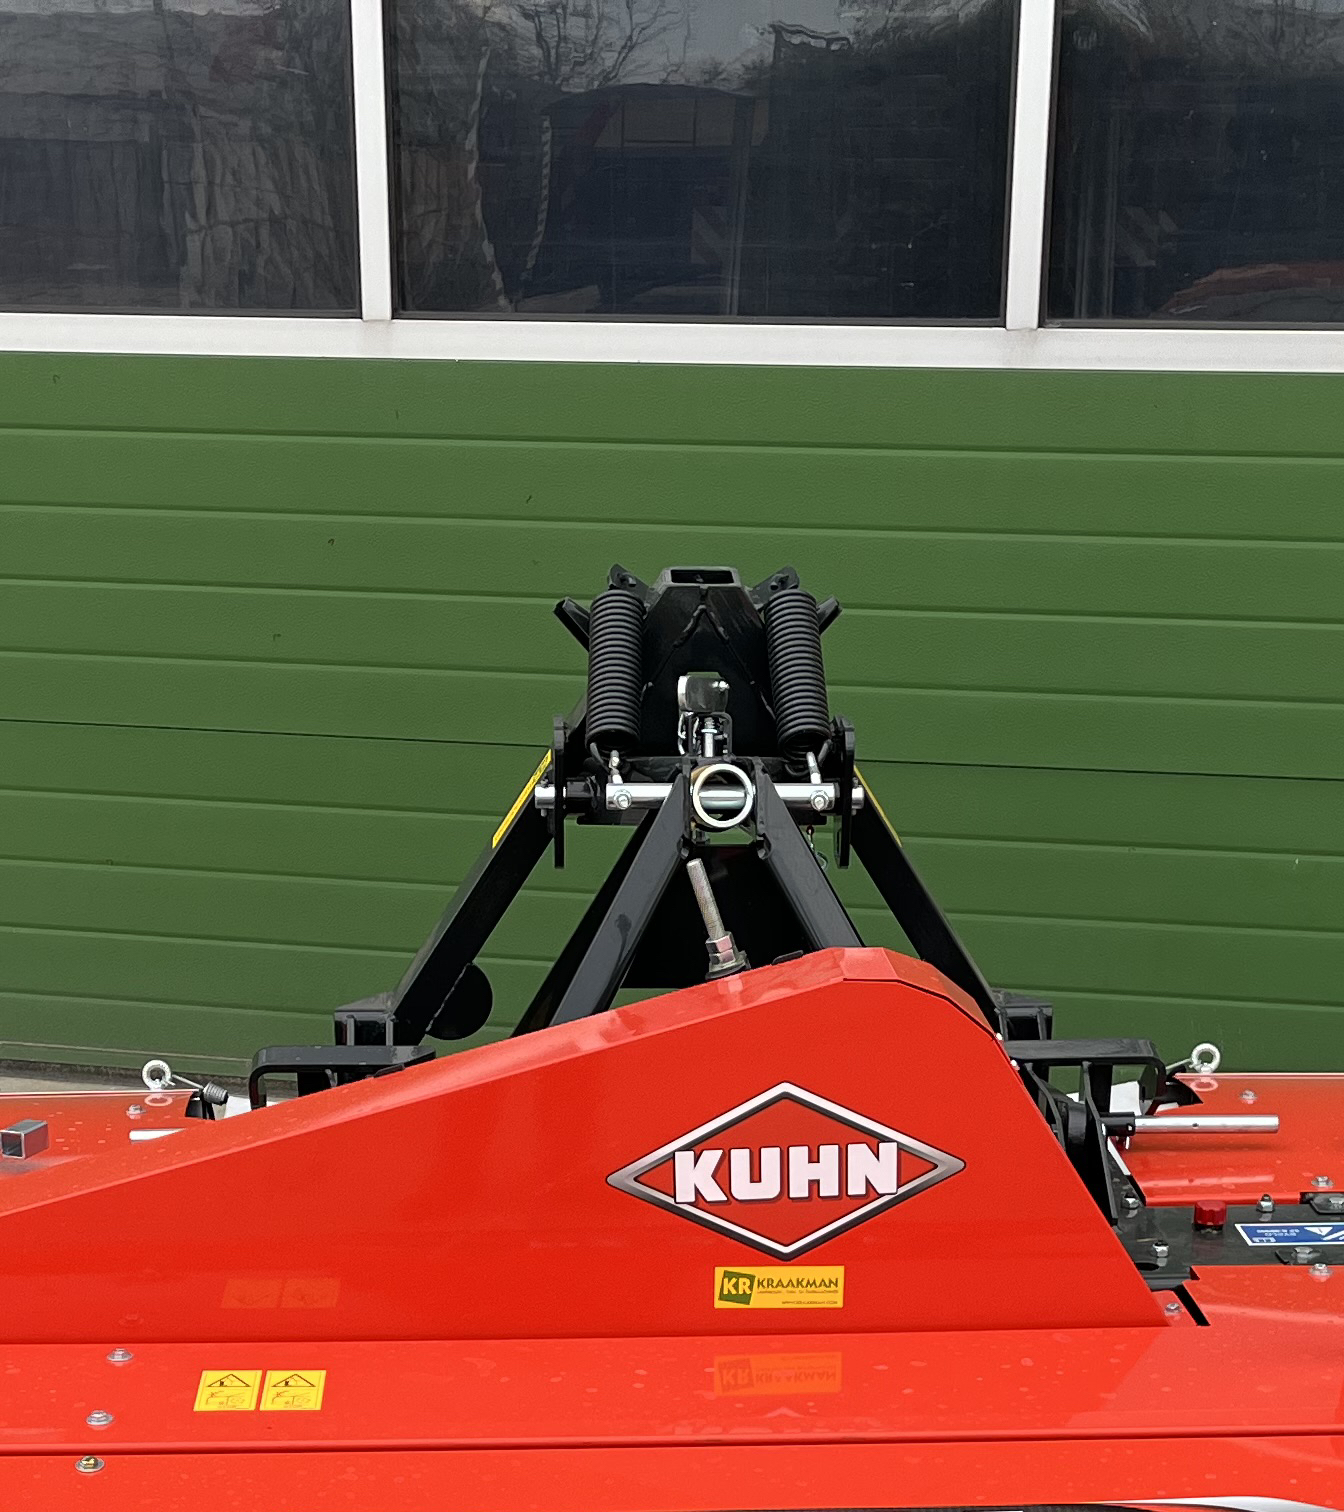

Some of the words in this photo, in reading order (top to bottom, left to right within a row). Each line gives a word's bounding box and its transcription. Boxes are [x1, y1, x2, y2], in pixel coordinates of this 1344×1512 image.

[674, 1142, 898, 1203] KUHN
[722, 1277, 752, 1295] KR
[757, 1277, 839, 1289] KRAAKMAN
